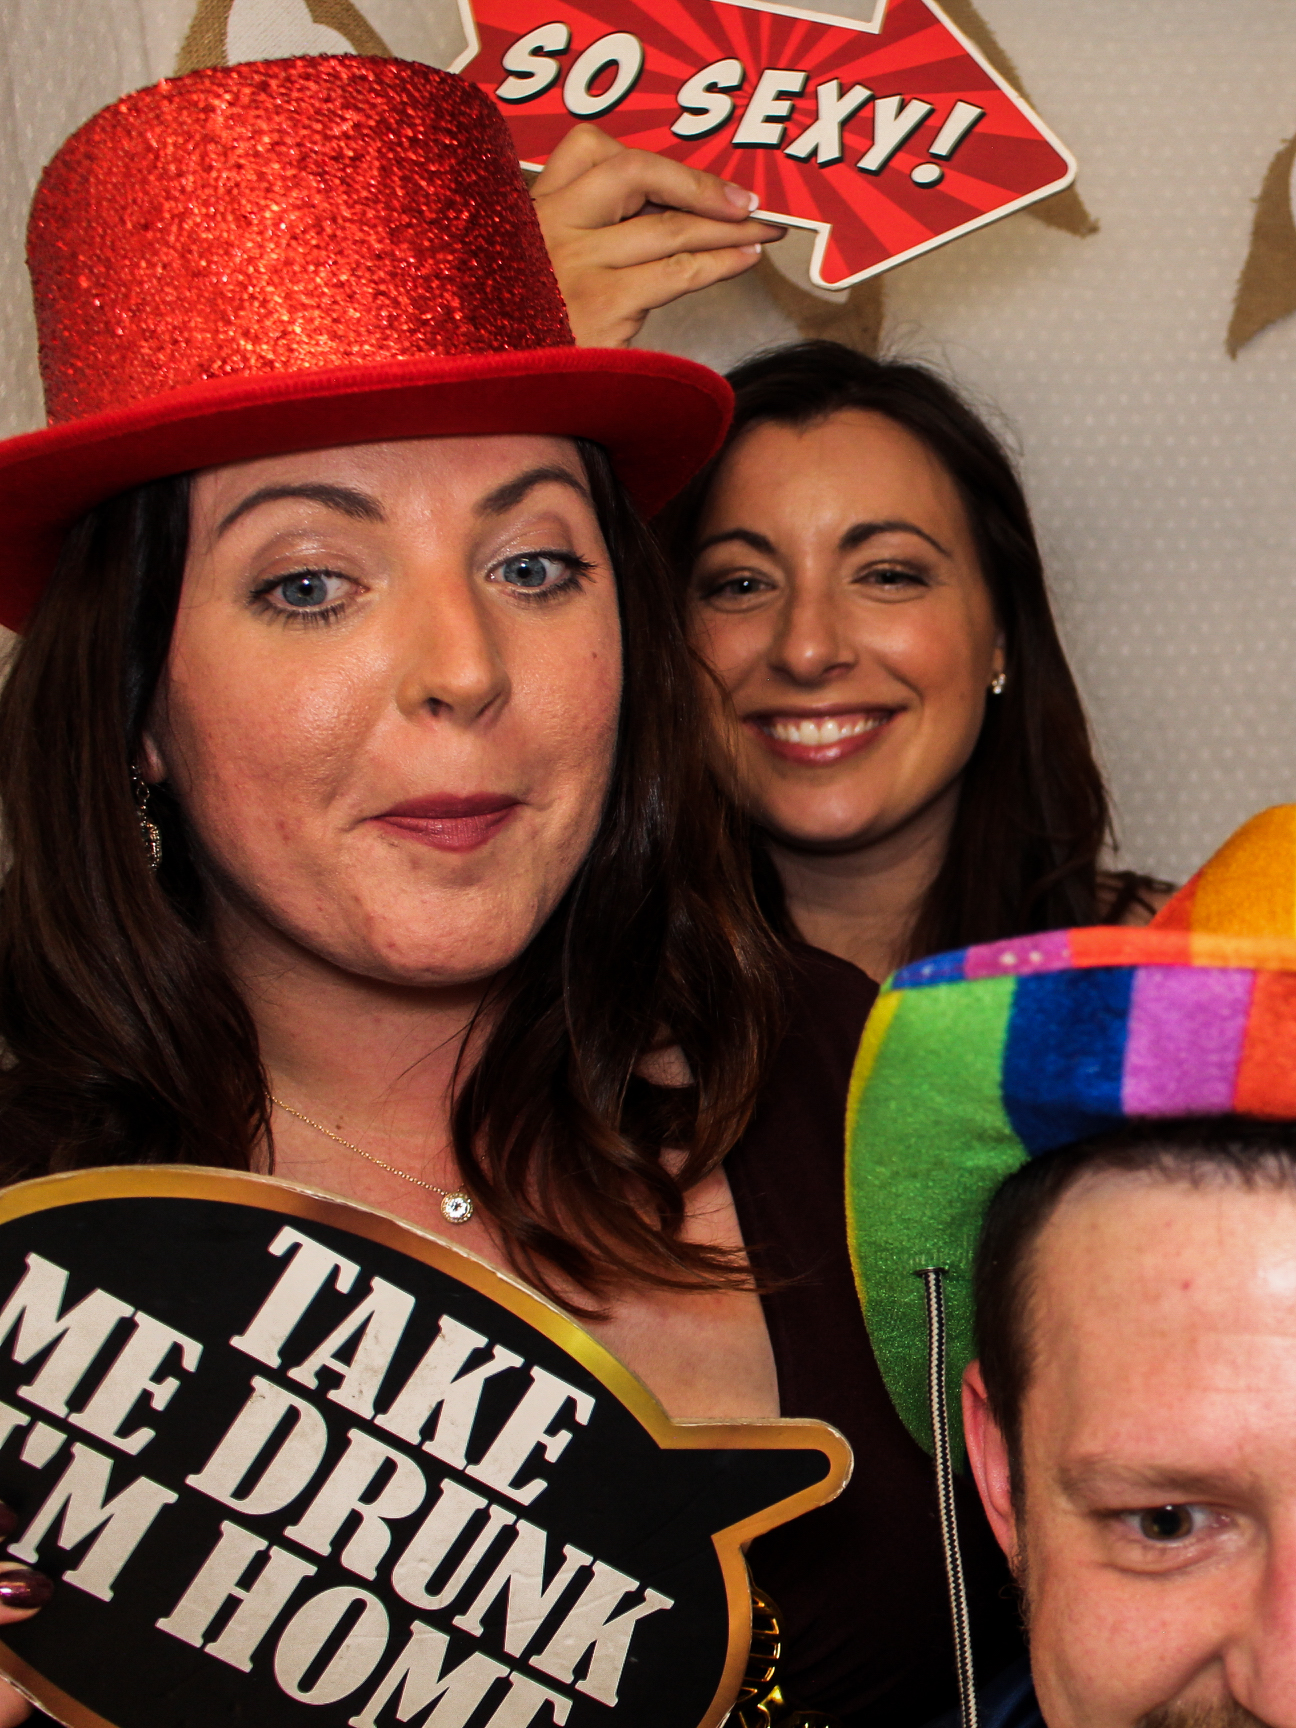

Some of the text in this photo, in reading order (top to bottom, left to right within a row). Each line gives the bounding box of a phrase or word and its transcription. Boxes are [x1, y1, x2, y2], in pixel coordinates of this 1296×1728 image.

[495, 22, 984, 186] SO SEXY!
[0, 1252, 675, 1708] ME DRUNK
[230, 1226, 596, 1507] TAKE
[0, 1401, 179, 1602] 'M
